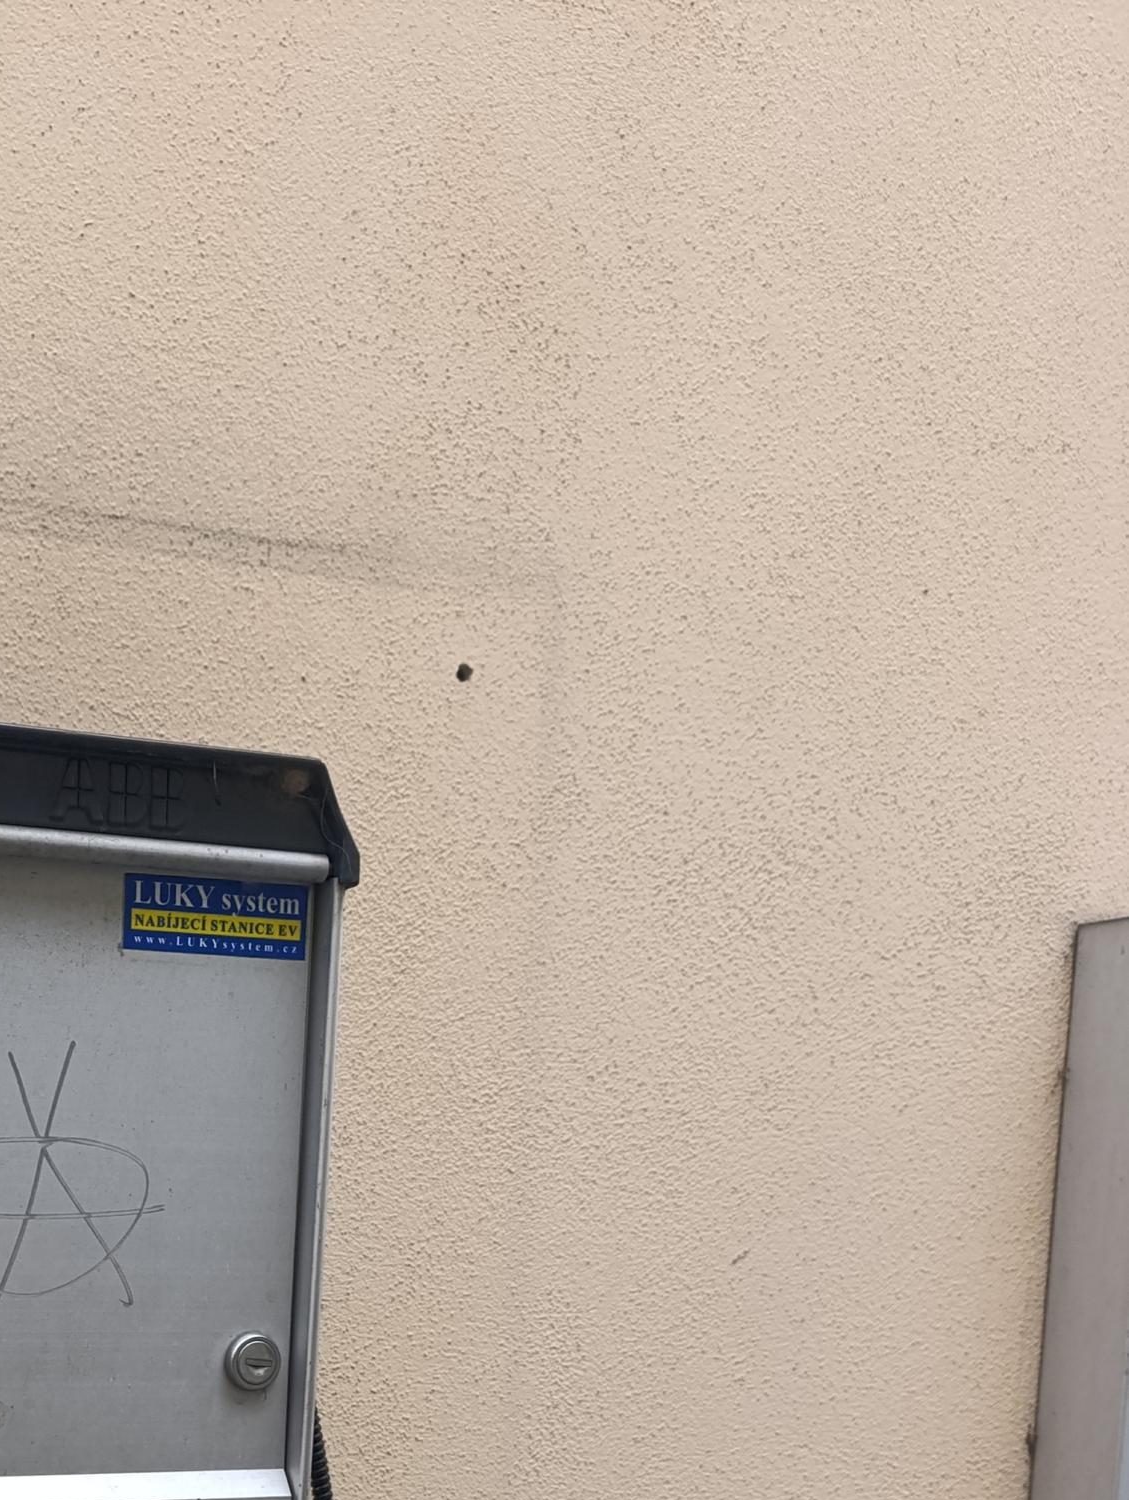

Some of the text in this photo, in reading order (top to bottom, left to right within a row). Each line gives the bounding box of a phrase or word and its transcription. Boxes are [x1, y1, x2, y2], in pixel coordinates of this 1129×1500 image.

[49, 757, 186, 832] ABB
[134, 879, 300, 917] LUKY system
[134, 913, 298, 937] NABÍJECÍ STANICE EV
